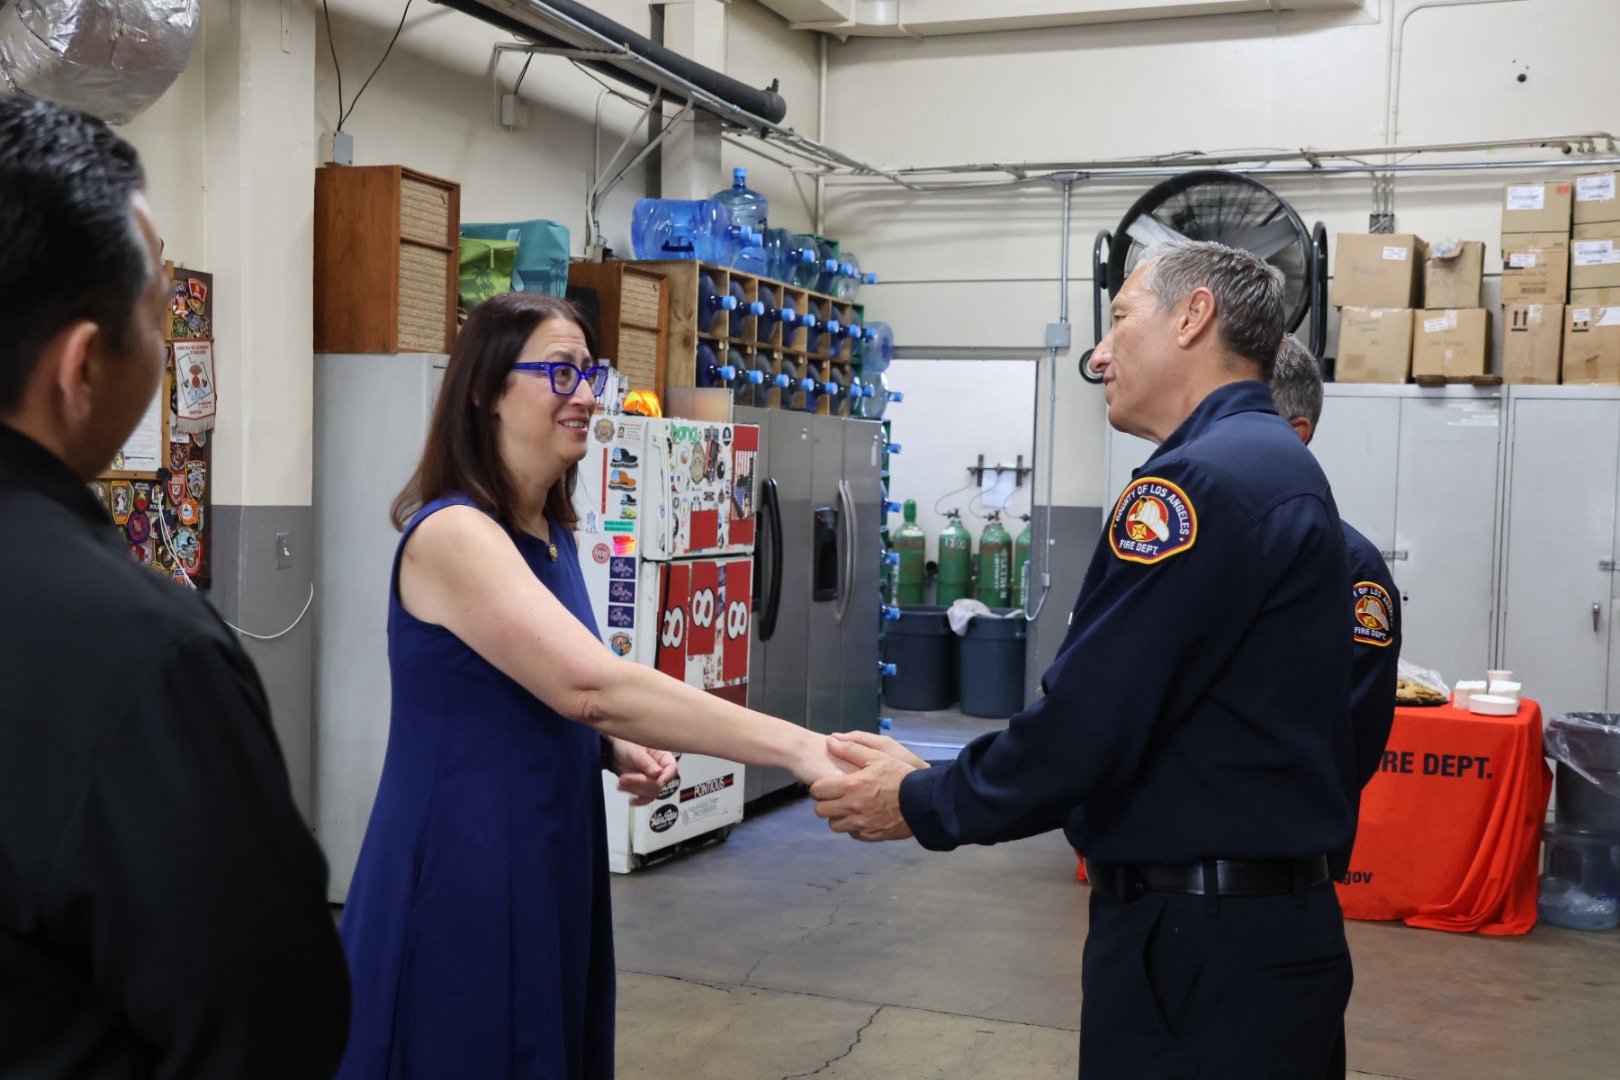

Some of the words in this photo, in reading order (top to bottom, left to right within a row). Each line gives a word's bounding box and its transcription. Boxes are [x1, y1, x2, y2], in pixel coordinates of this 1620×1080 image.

[1115, 490, 1136, 521] COUNTY
[1137, 484, 1148, 495] OF
[1150, 484, 1168, 497] LOS
[1166, 493, 1190, 535] ANGELES
[1119, 539, 1136, 550] FIRE
[1136, 542, 1159, 556] DEPT.
[1358, 587, 1368, 595] OF
[1370, 588, 1382, 598] LOS
[1354, 626, 1370, 636] FIRE
[1381, 750, 1414, 774] RE
[1423, 753, 1492, 779] DEPT.
